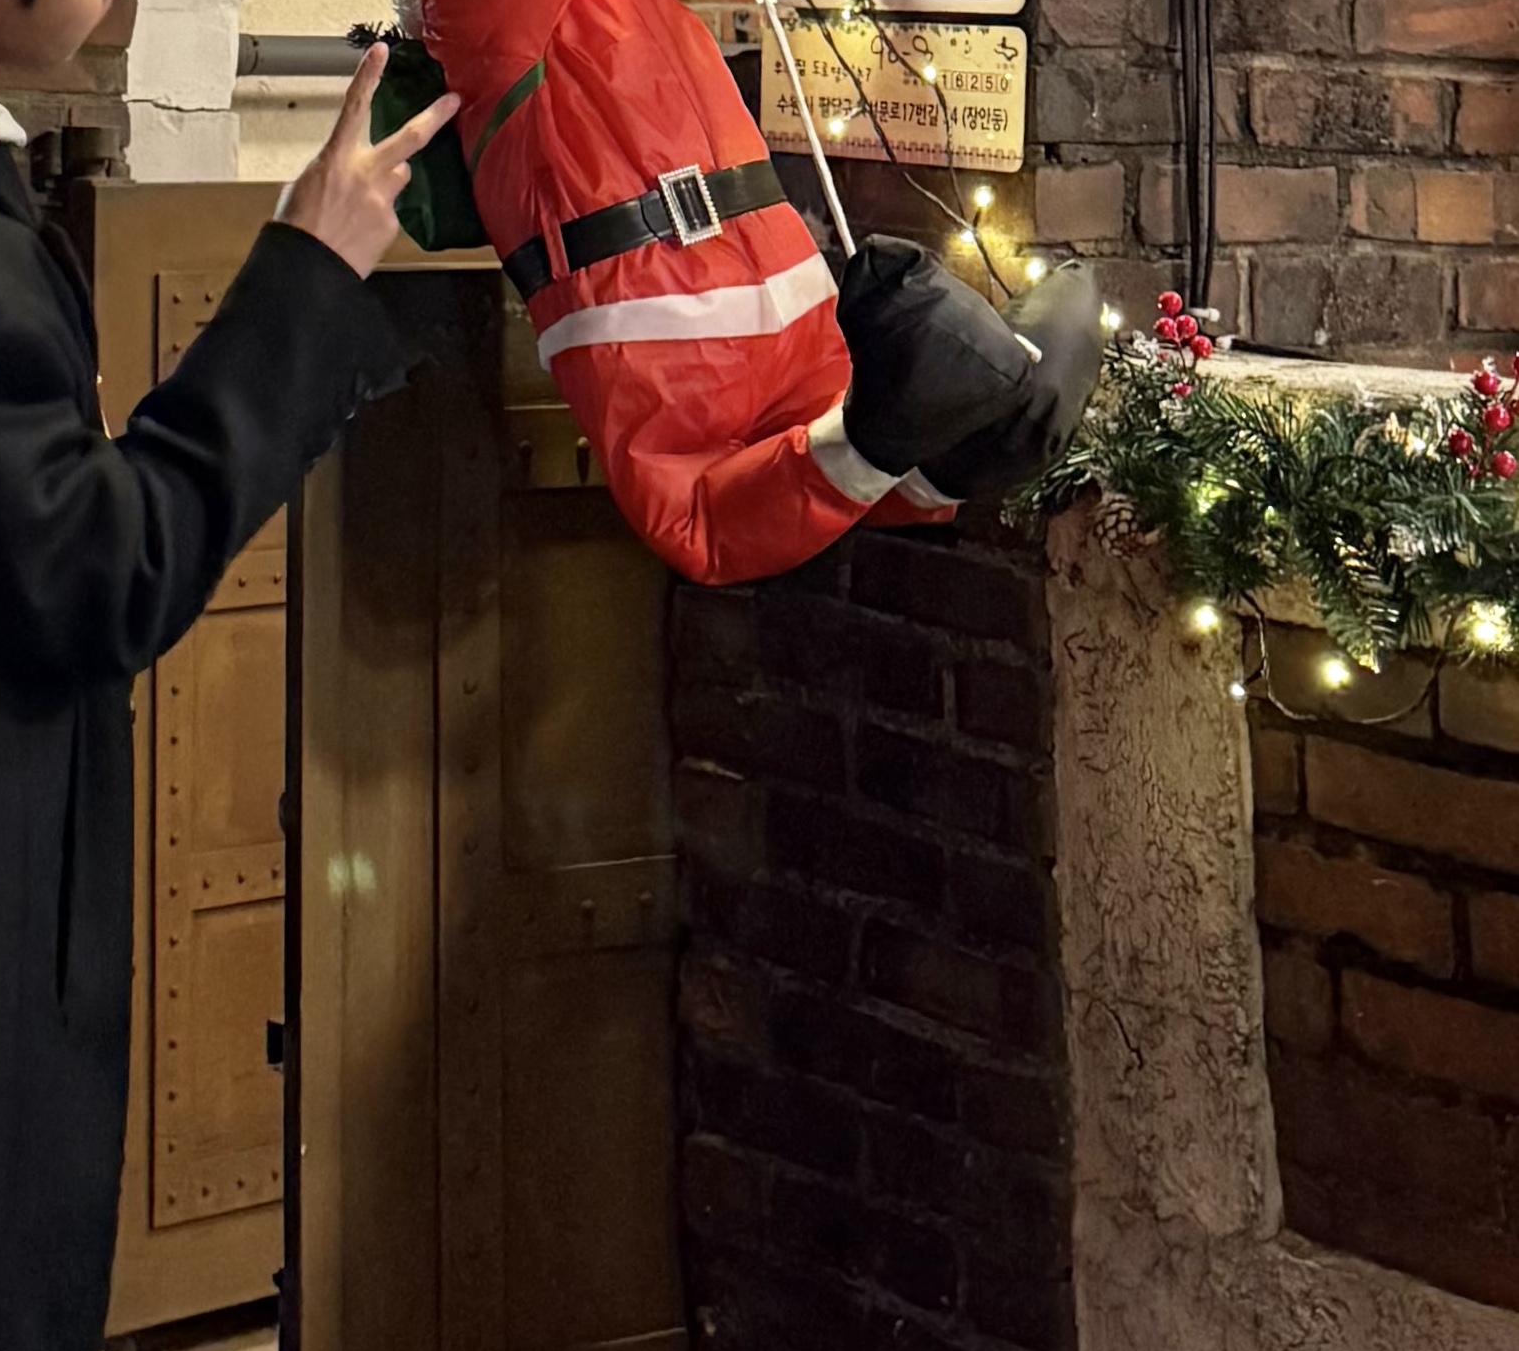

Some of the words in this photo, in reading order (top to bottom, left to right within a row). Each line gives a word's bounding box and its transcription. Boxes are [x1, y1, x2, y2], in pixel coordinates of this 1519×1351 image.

[774, 58, 806, 77] 우집
[941, 73, 1009, 91] 16250
[859, 98, 939, 127] 문로17번길
[962, 105, 1008, 132] (장안동)
